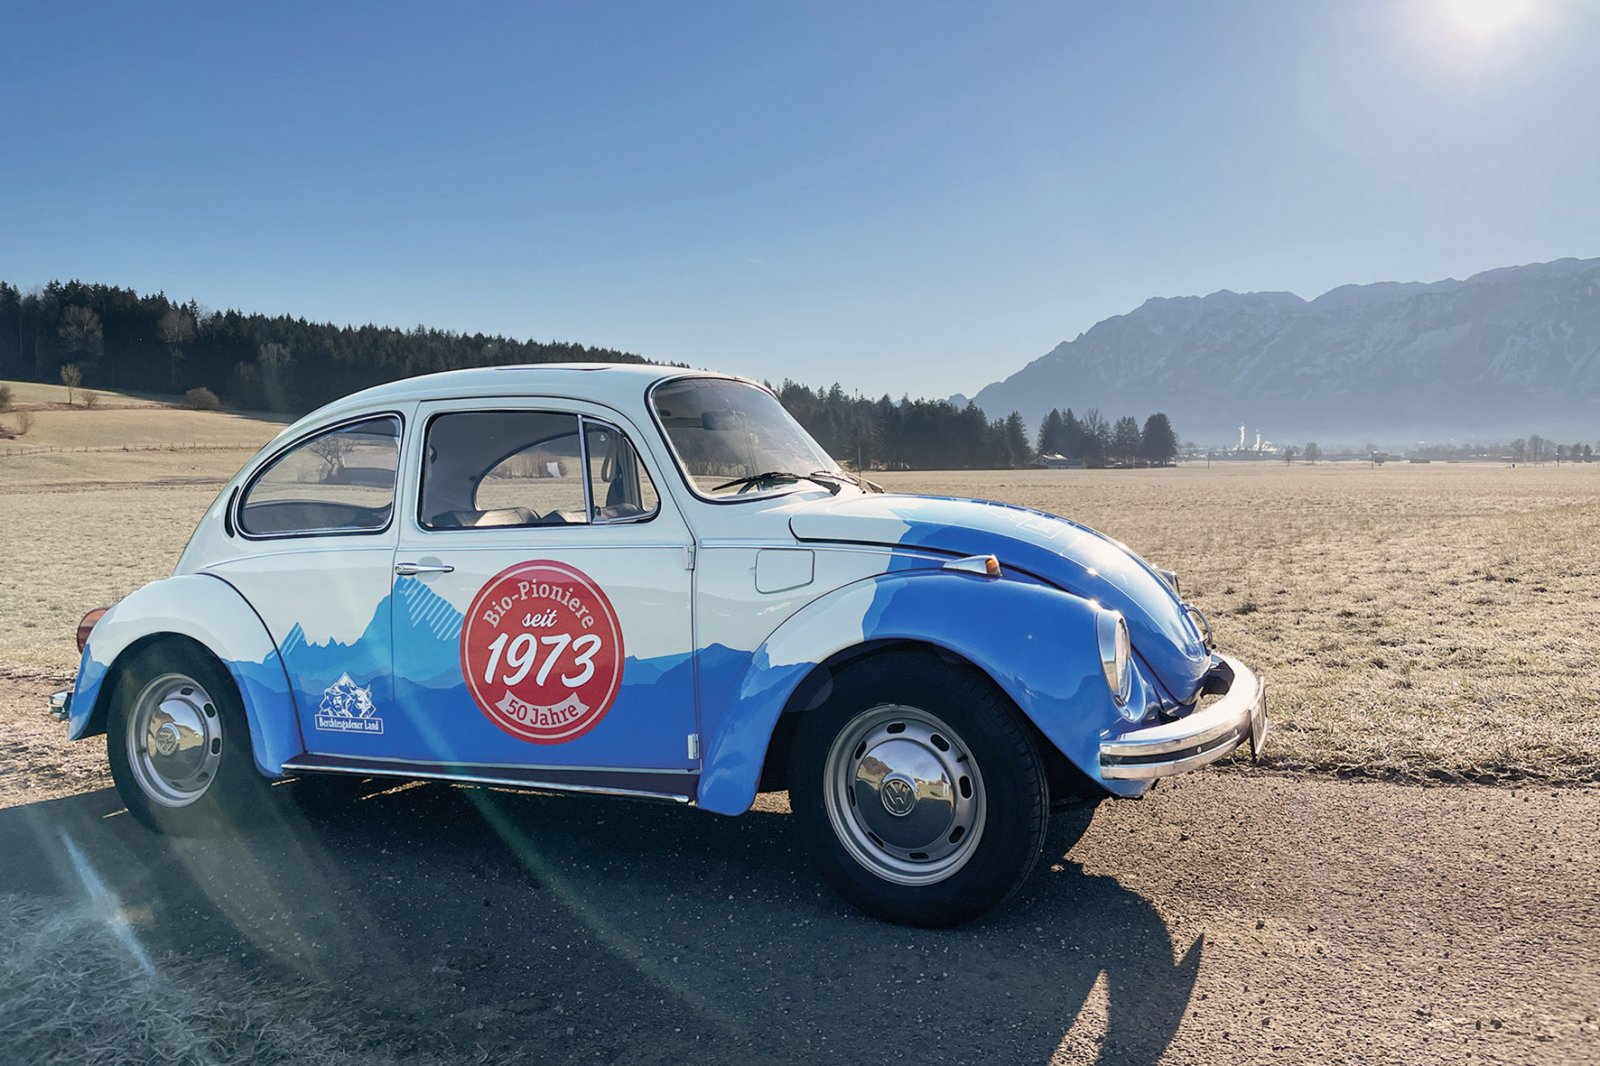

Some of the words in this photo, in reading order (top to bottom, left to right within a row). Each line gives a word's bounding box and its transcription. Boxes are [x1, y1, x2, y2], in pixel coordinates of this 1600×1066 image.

[483, 579, 595, 628] Bio-Pioniere
[522, 609, 557, 627] seit
[484, 633, 602, 687] 1973
[364, 719, 378, 730] Land
[505, 699, 527, 720] 50
[530, 704, 578, 725] Jahre
